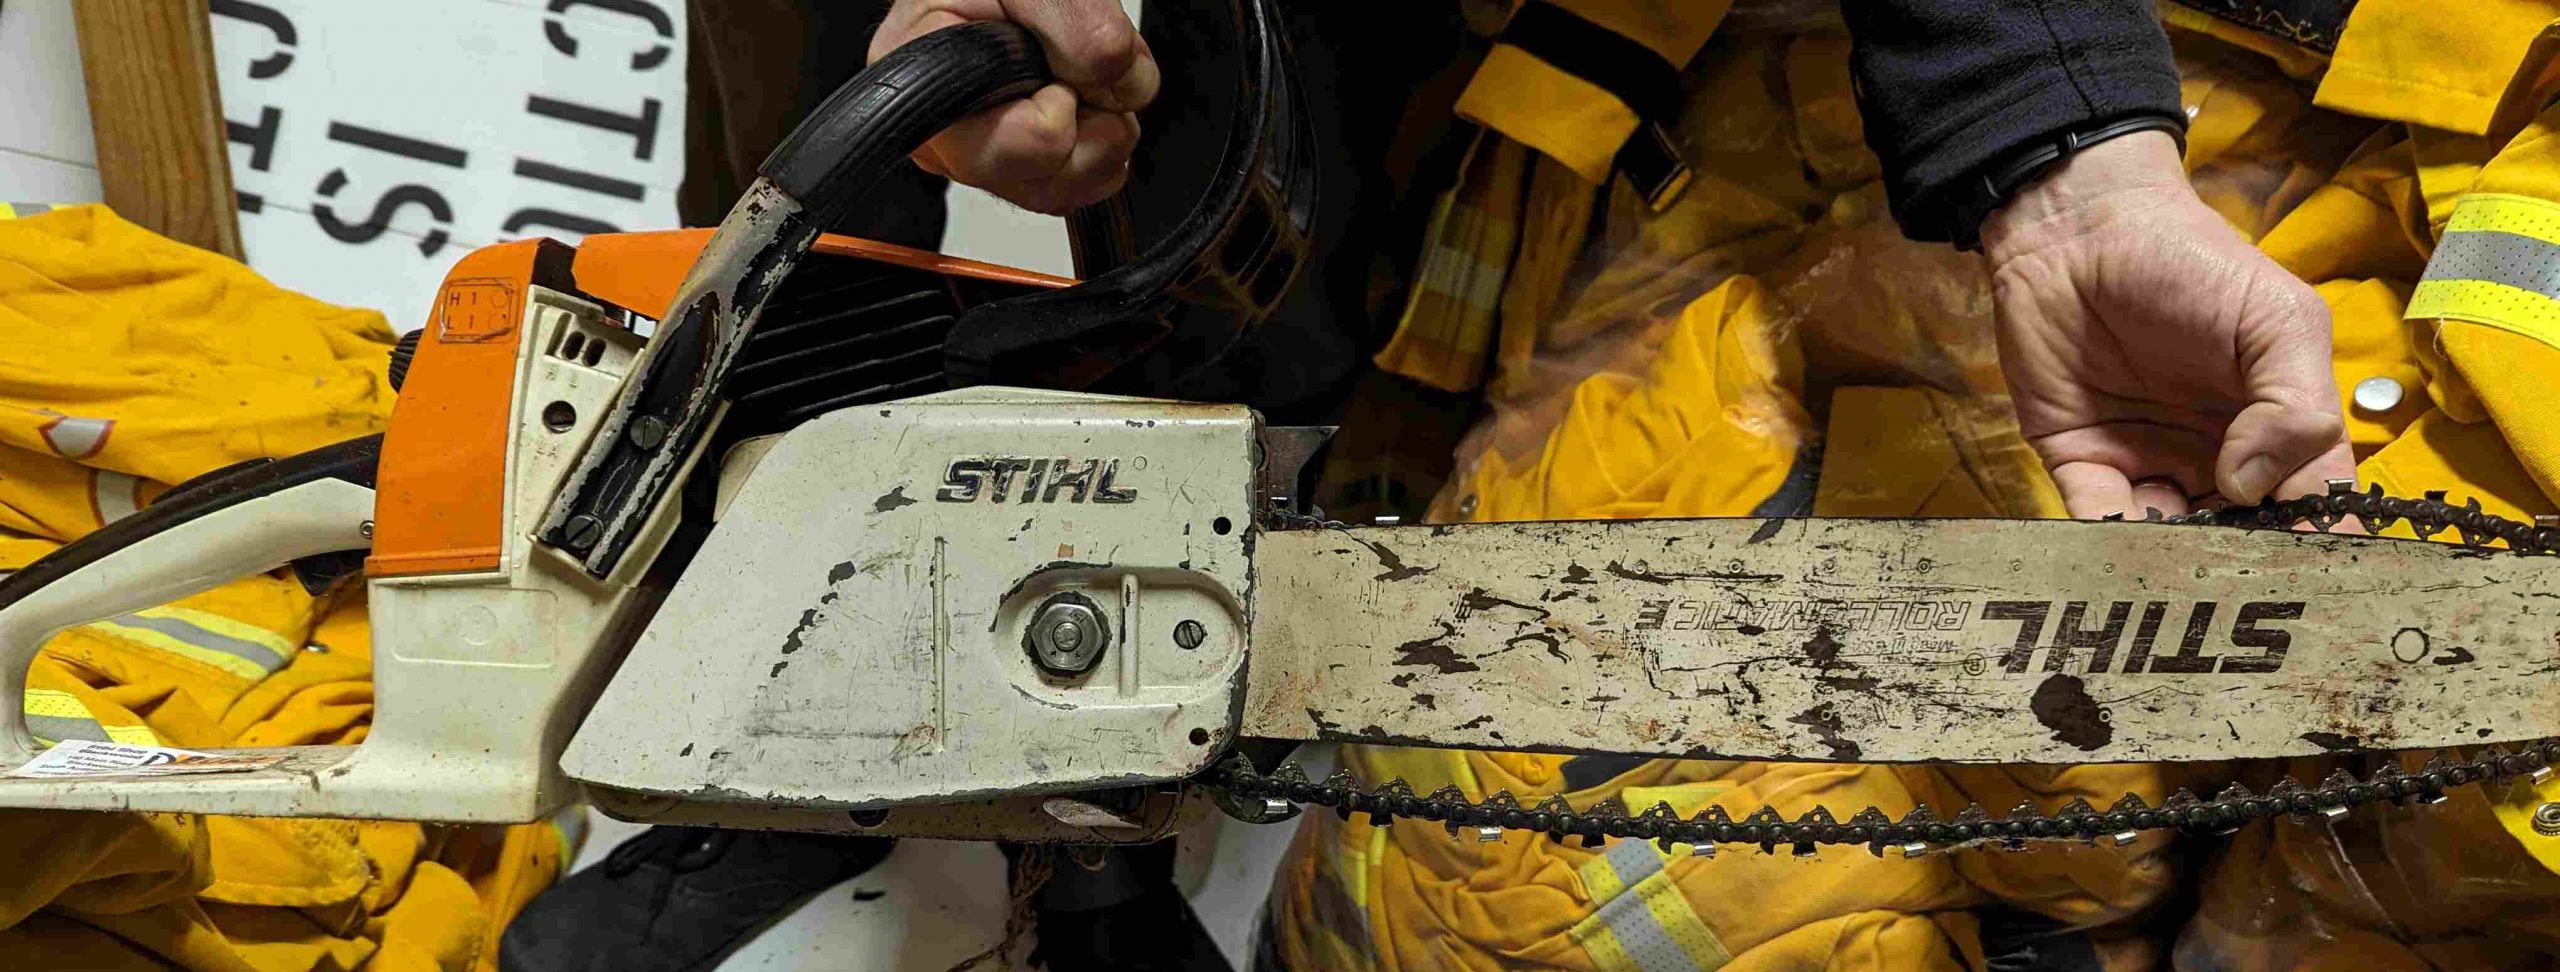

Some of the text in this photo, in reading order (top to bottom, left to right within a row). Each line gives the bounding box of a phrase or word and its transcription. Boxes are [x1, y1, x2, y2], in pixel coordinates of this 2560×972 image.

[312, 119, 468, 259] IS
[449, 291, 461, 306] H
[935, 455, 1138, 504] STIHL
[1980, 600, 2307, 674] STIHL
